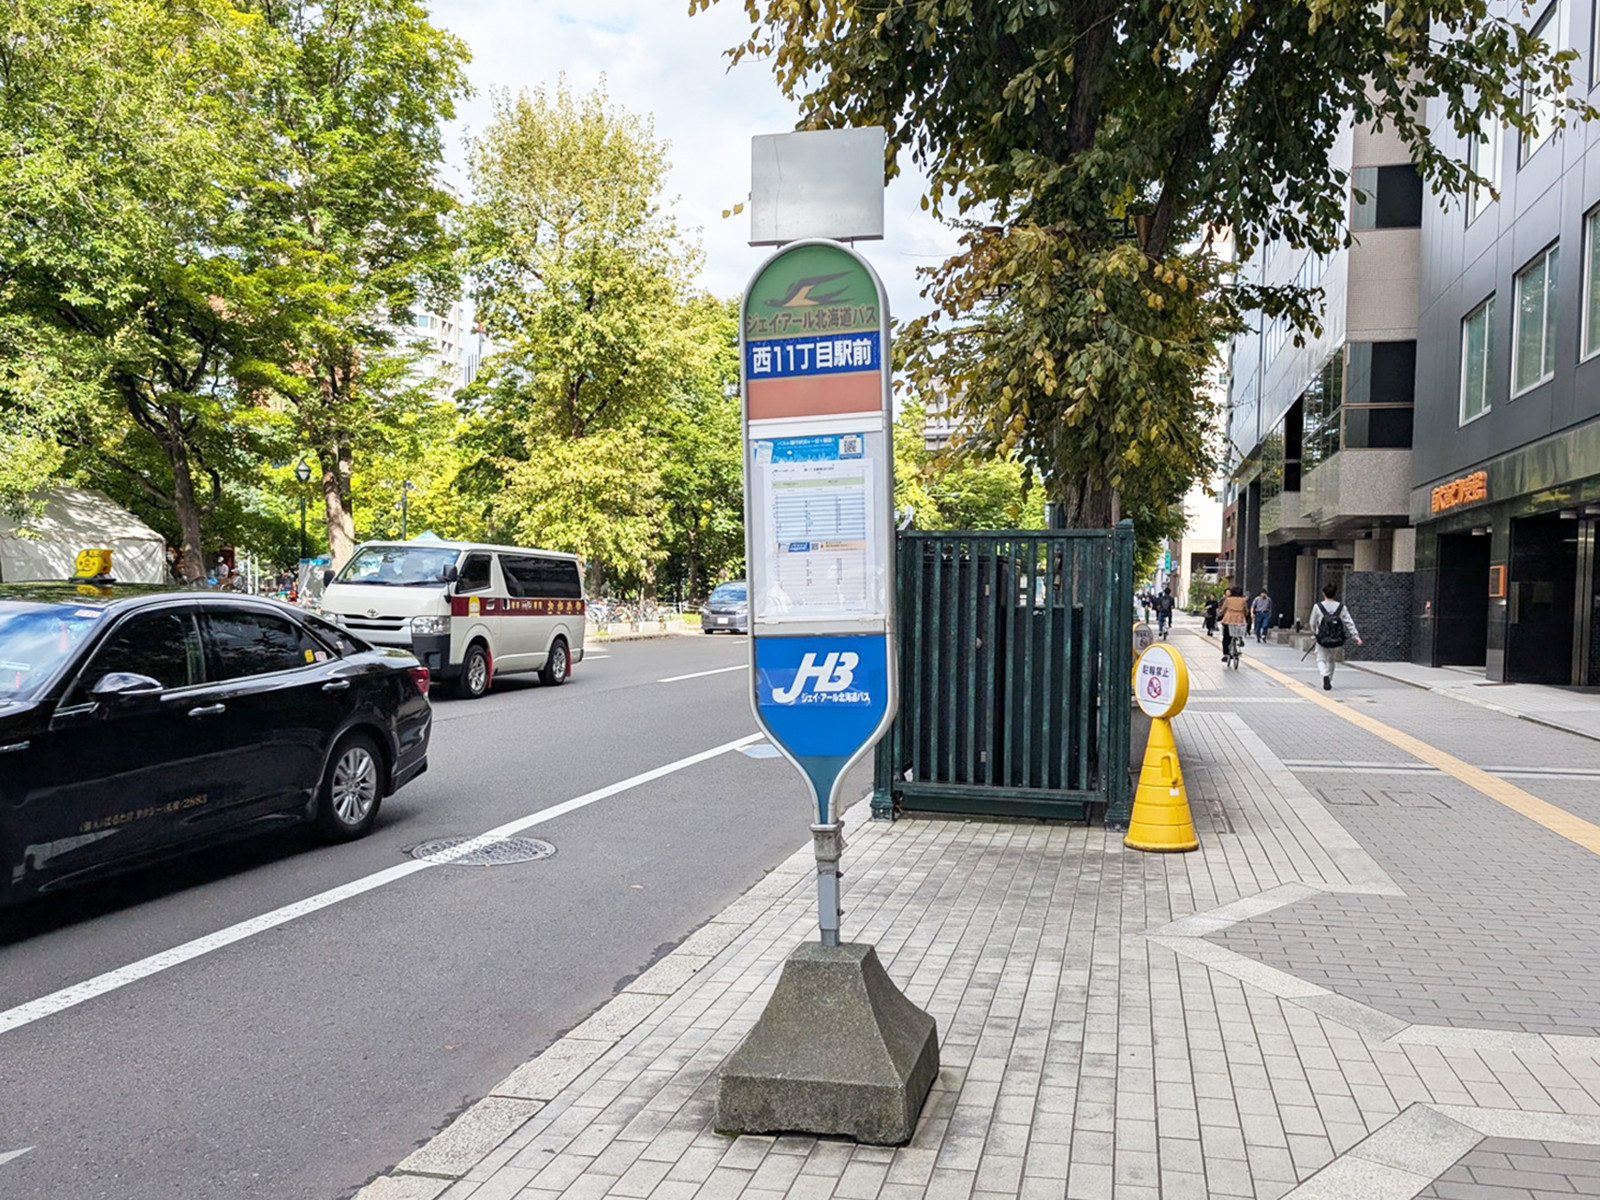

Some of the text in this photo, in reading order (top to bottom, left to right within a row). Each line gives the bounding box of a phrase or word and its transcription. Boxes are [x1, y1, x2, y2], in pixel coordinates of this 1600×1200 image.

[753, 338, 872, 373] 西11丁目駅前
[772, 652, 860, 703] JHB
